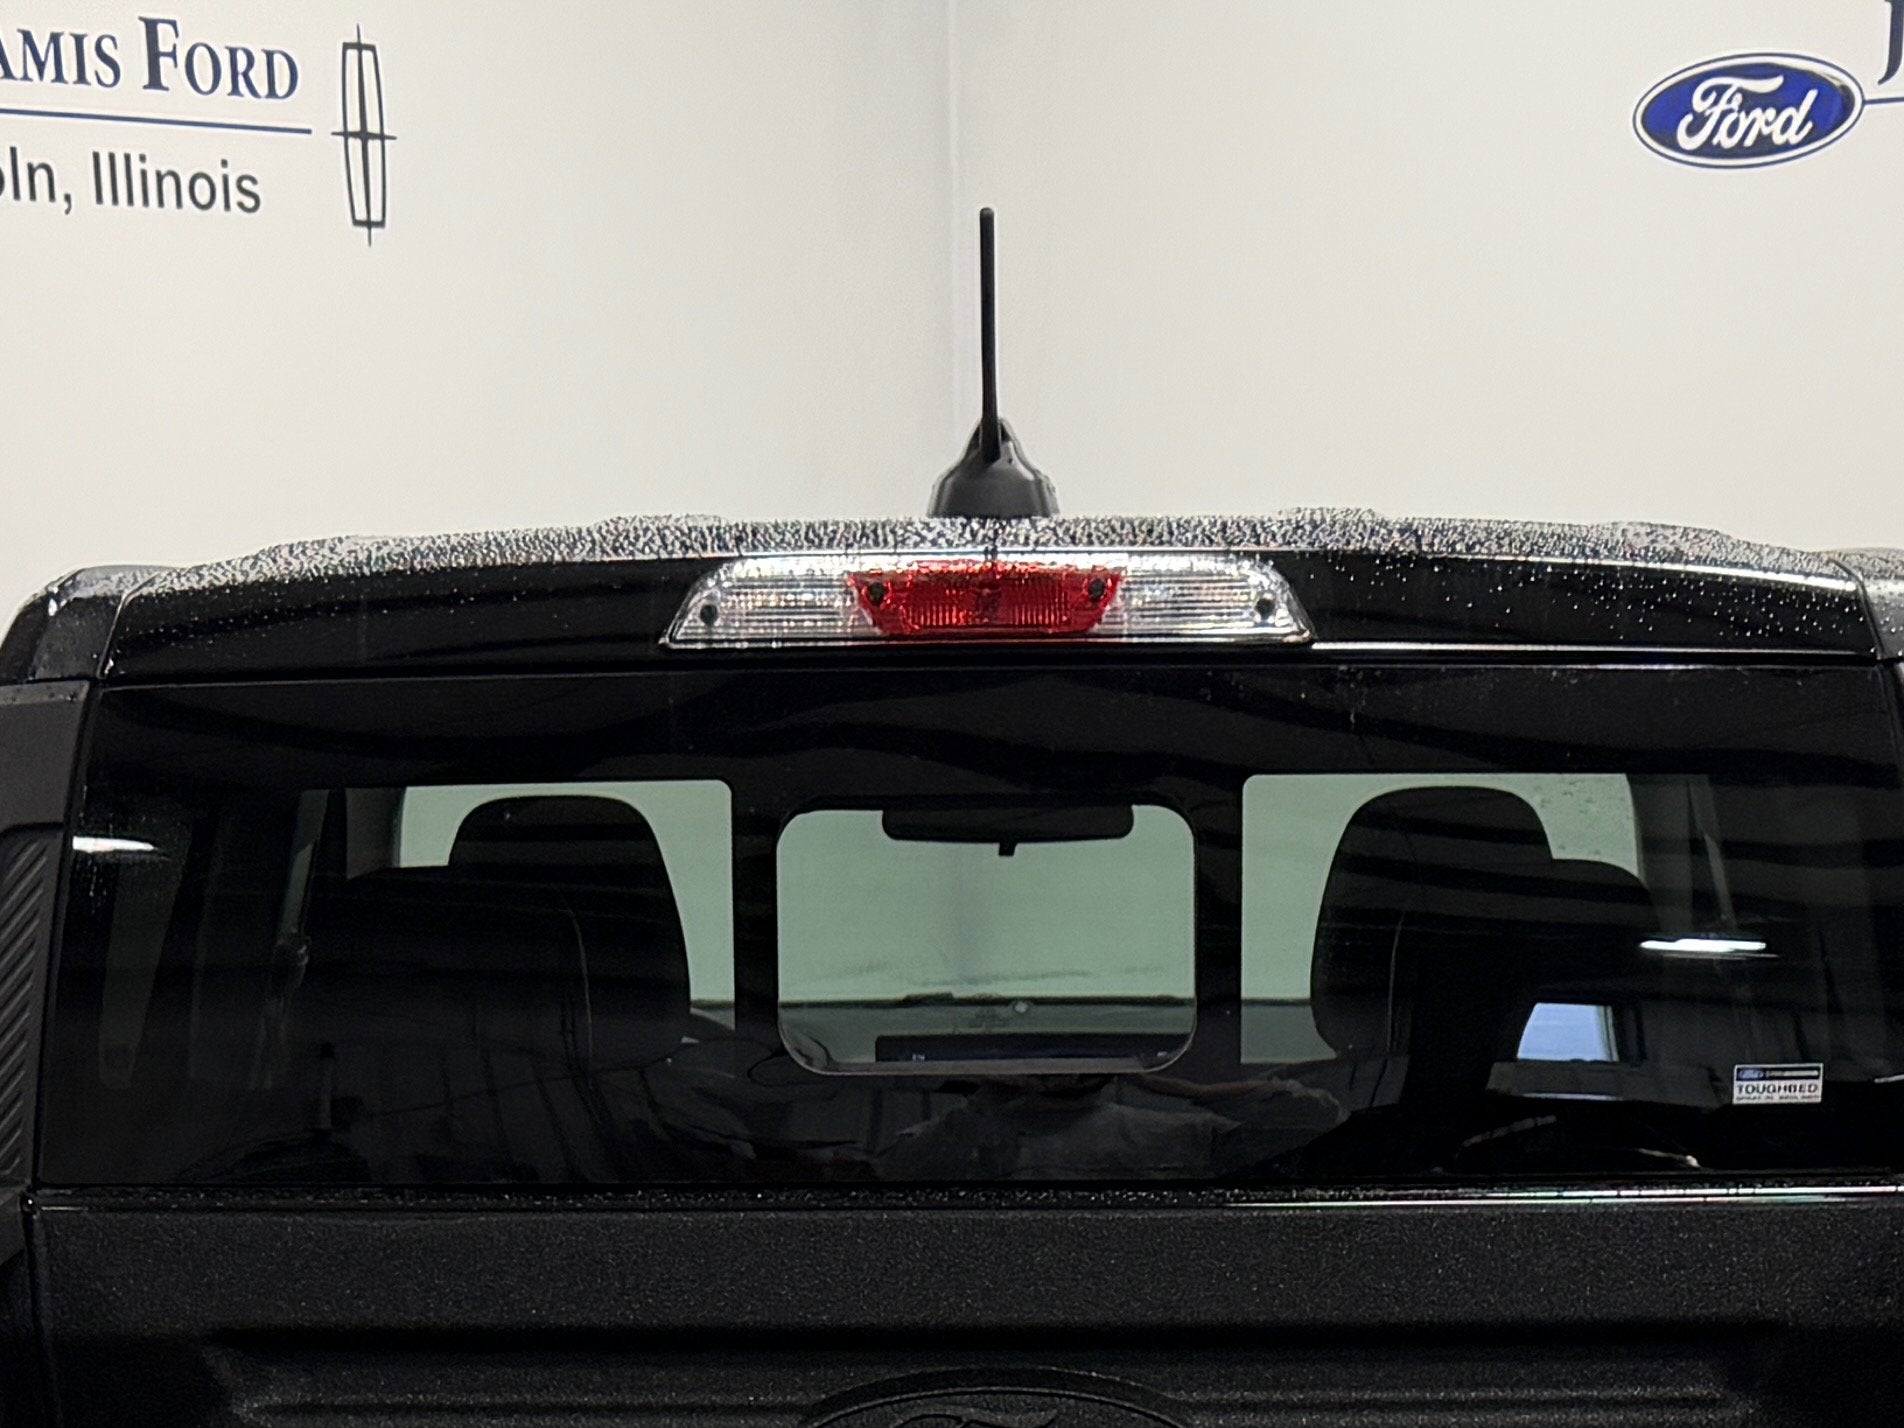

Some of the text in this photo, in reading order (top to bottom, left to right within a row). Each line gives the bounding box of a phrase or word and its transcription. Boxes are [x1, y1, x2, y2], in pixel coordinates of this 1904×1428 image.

[137, 16, 299, 100] FORD
[1676, 74, 1820, 151] Ford
[91, 150, 262, 214] Illinois
